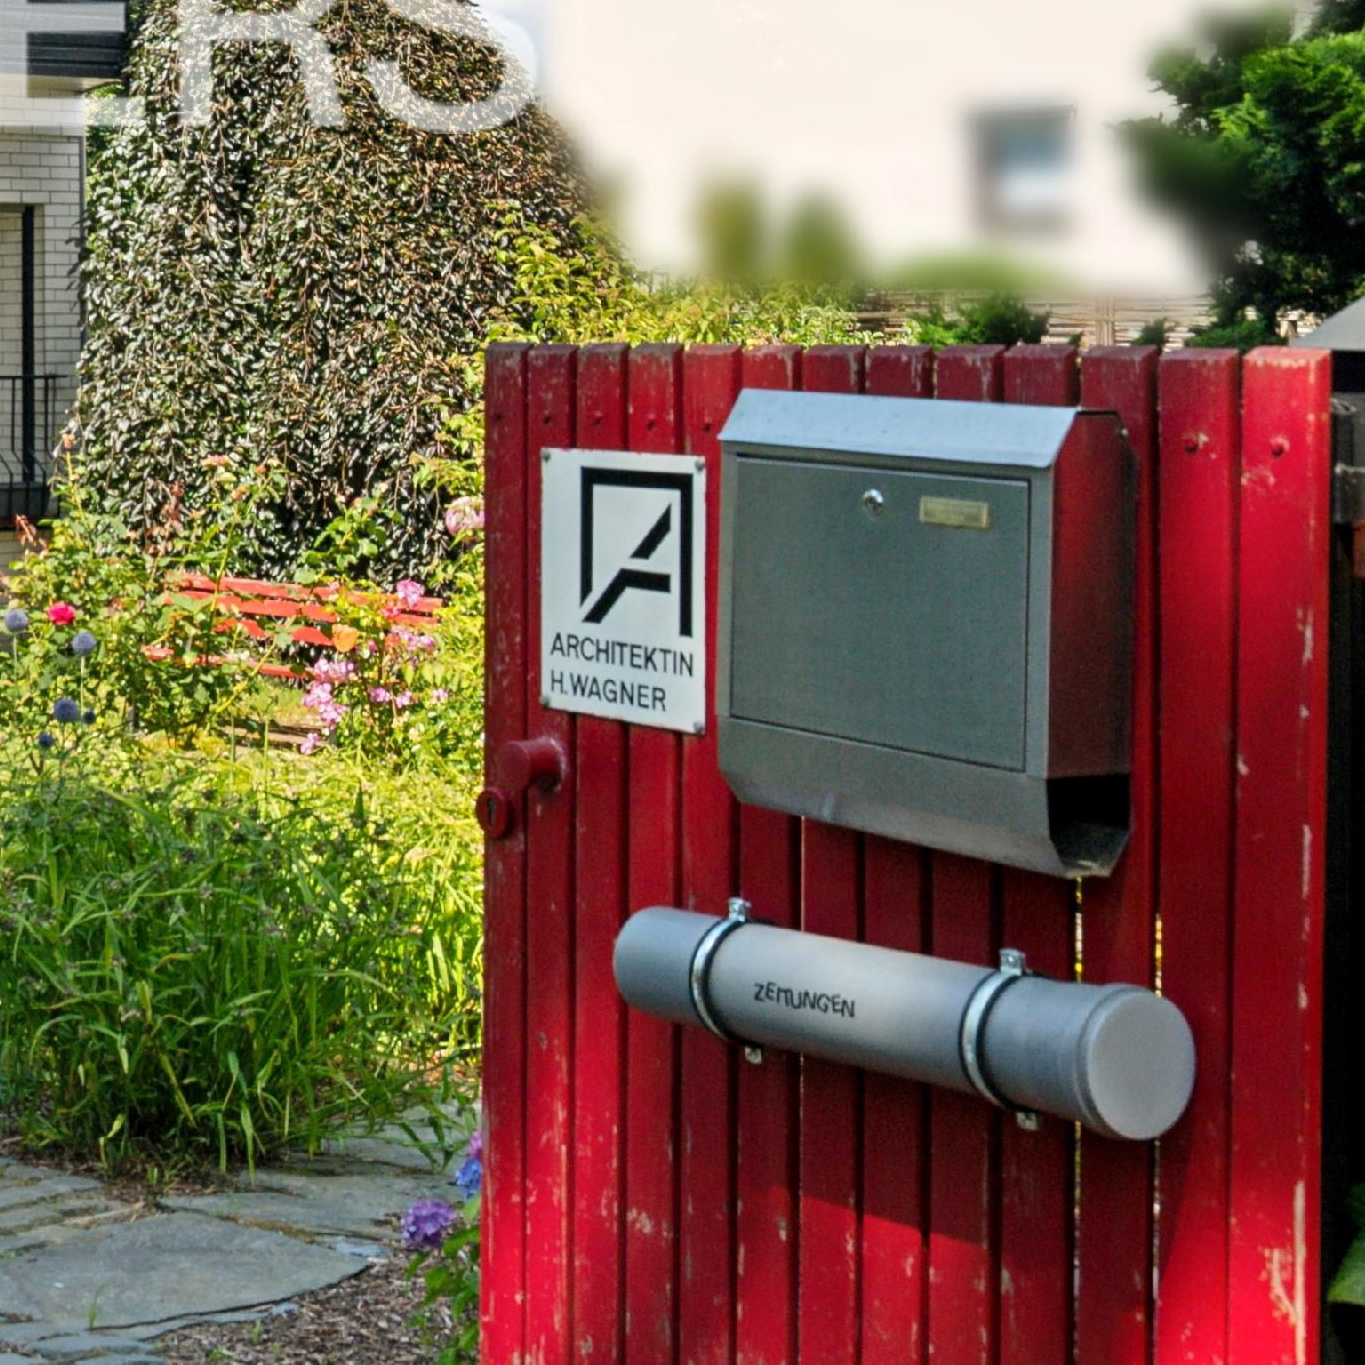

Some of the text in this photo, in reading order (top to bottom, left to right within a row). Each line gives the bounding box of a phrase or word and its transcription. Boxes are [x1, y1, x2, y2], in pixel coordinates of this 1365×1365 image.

[550, 632, 694, 677] ARCHITEKTIN
[550, 668, 667, 712] H.WAGNER
[754, 982, 855, 1018] ZEITUNGEN
